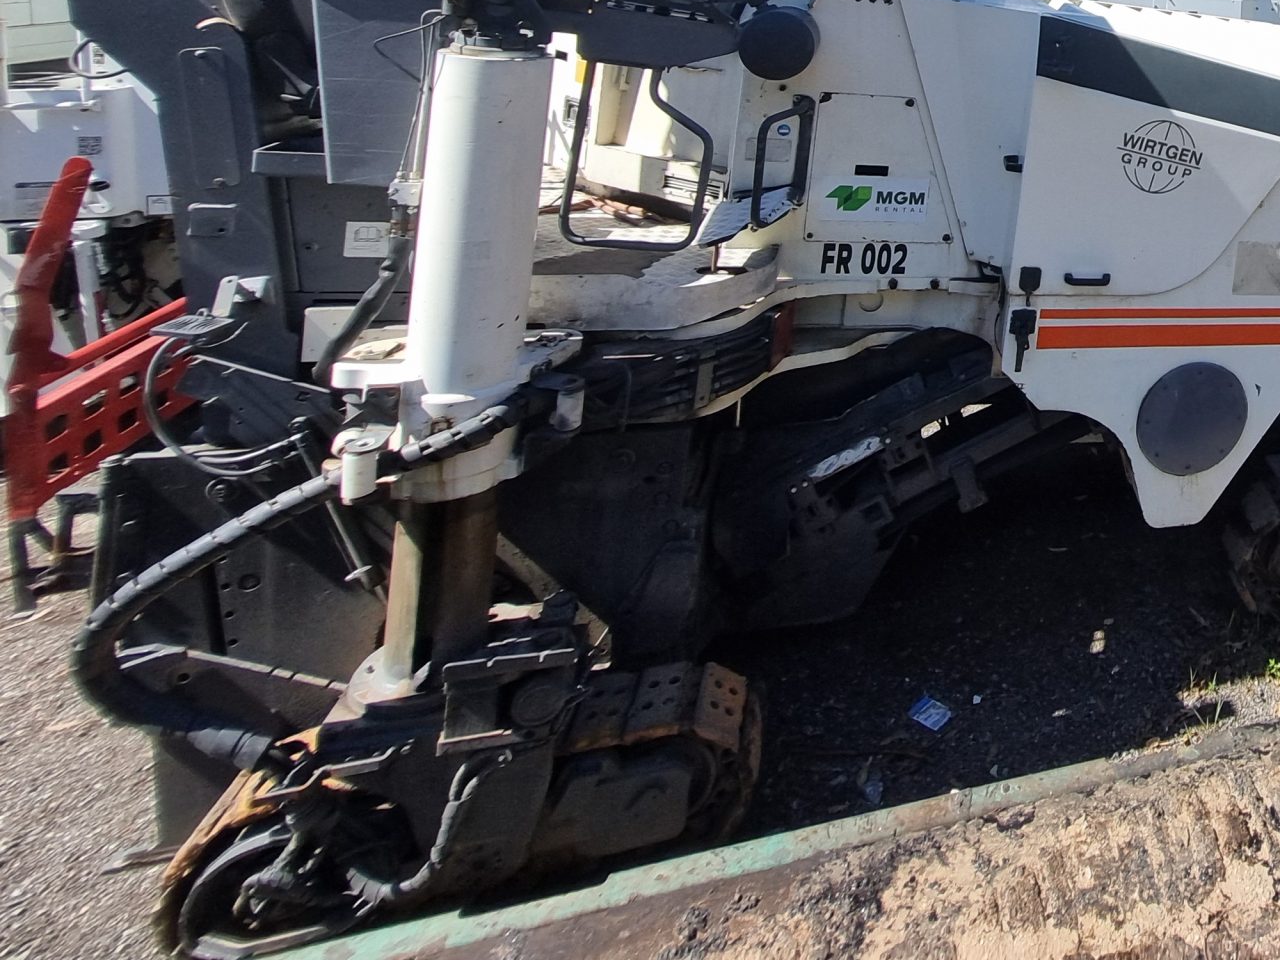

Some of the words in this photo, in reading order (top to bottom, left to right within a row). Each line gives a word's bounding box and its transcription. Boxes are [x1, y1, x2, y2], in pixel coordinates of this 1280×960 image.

[1123, 132, 1203, 166] WIRTGEN
[1121, 152, 1192, 178] GROUP
[876, 191, 925, 205] MGM
[821, 243, 853, 274] FR
[861, 243, 908, 275] 002
